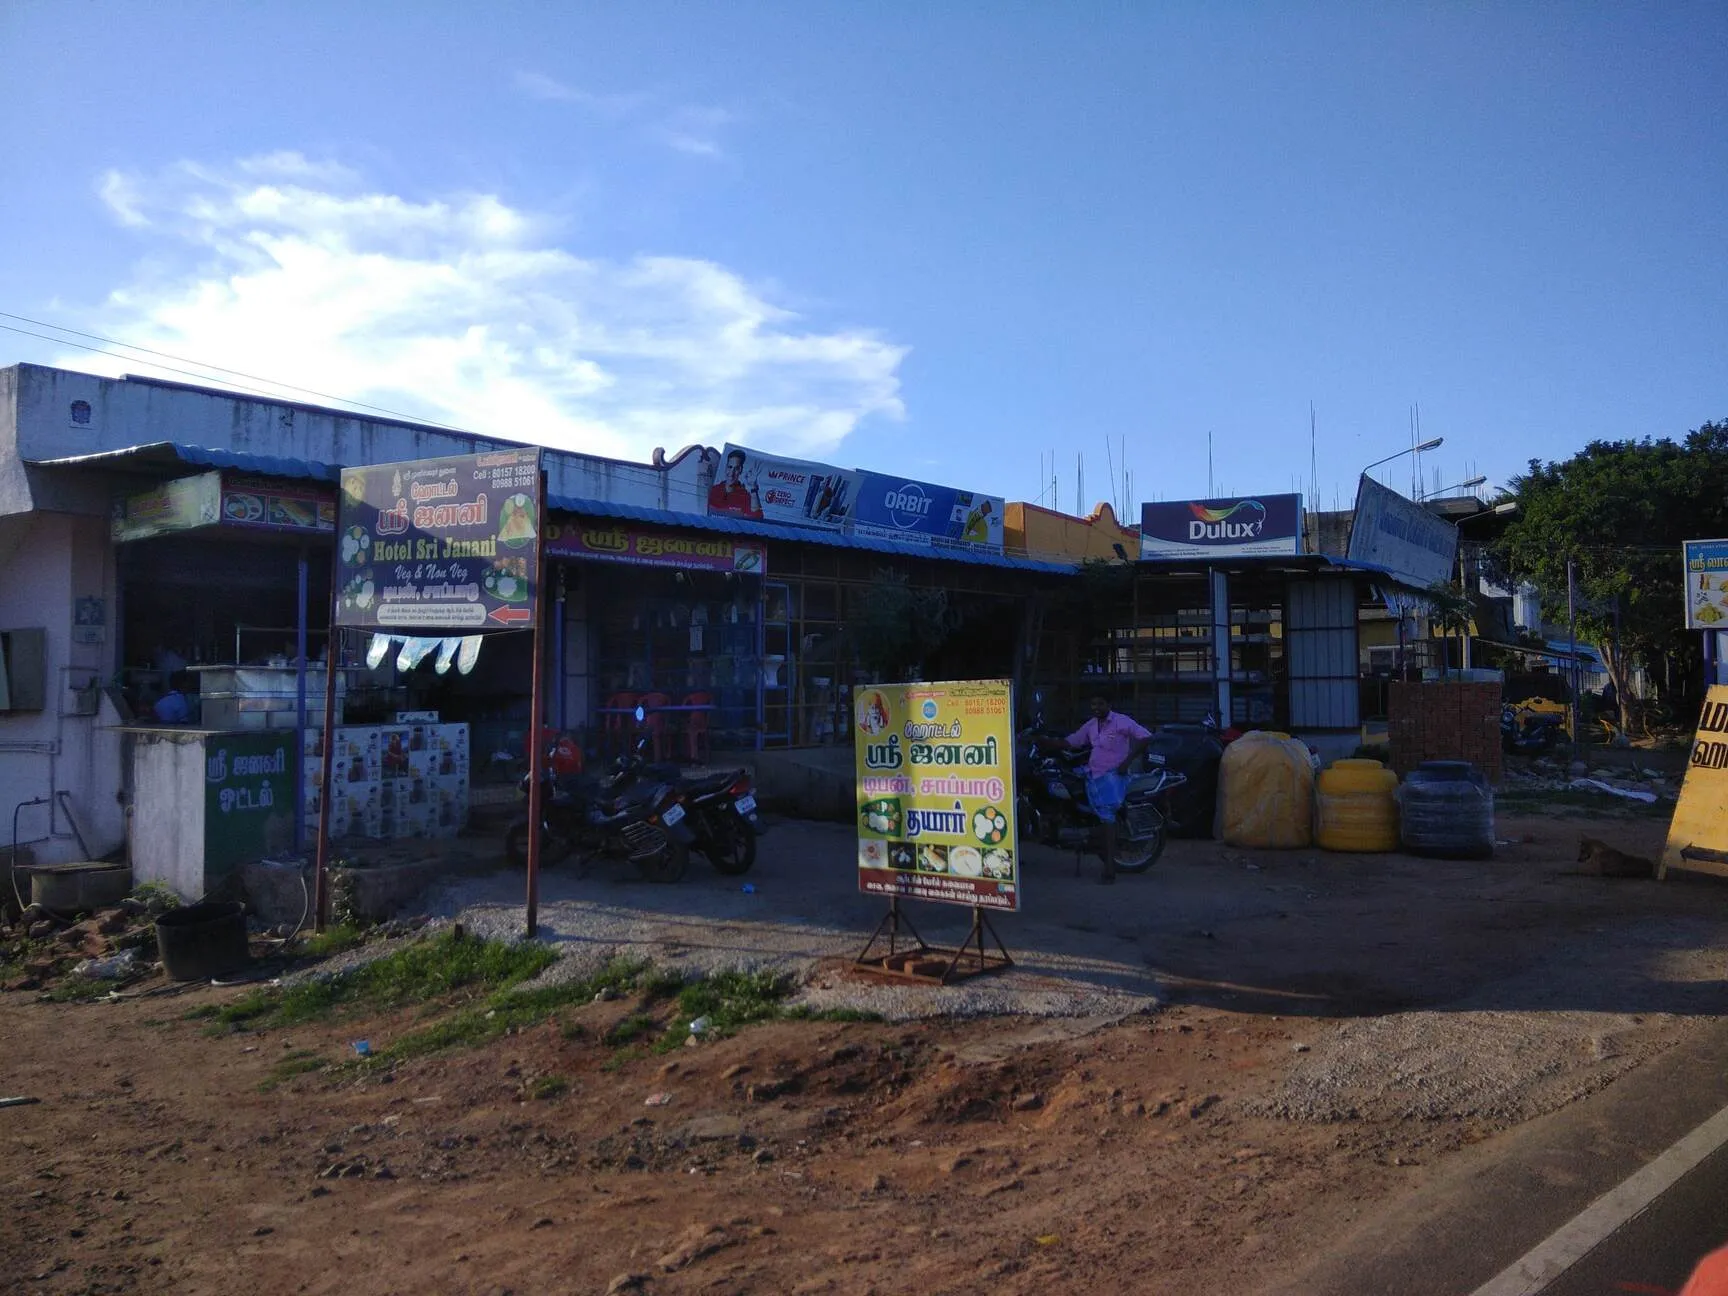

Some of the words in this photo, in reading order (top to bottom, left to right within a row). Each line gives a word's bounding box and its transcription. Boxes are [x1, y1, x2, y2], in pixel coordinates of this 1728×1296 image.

[778, 472, 806, 484] PRINCE
[414, 493, 488, 529] ஜனனி
[1189, 521, 1255, 540] Dulux
[373, 540, 412, 561] Hotel
[416, 537, 438, 559] Sri
[443, 535, 497, 557] Janani
[395, 564, 412, 582] Veg
[415, 565, 423, 577] &
[426, 564, 446, 579] Non
[450, 561, 468, 582] Veg
[865, 735, 903, 769] ஸ்ரீ
[910, 736, 998, 766] ஜனனி
[920, 776, 1004, 802] சாப்பாடு
[907, 800, 966, 838] தயார்
